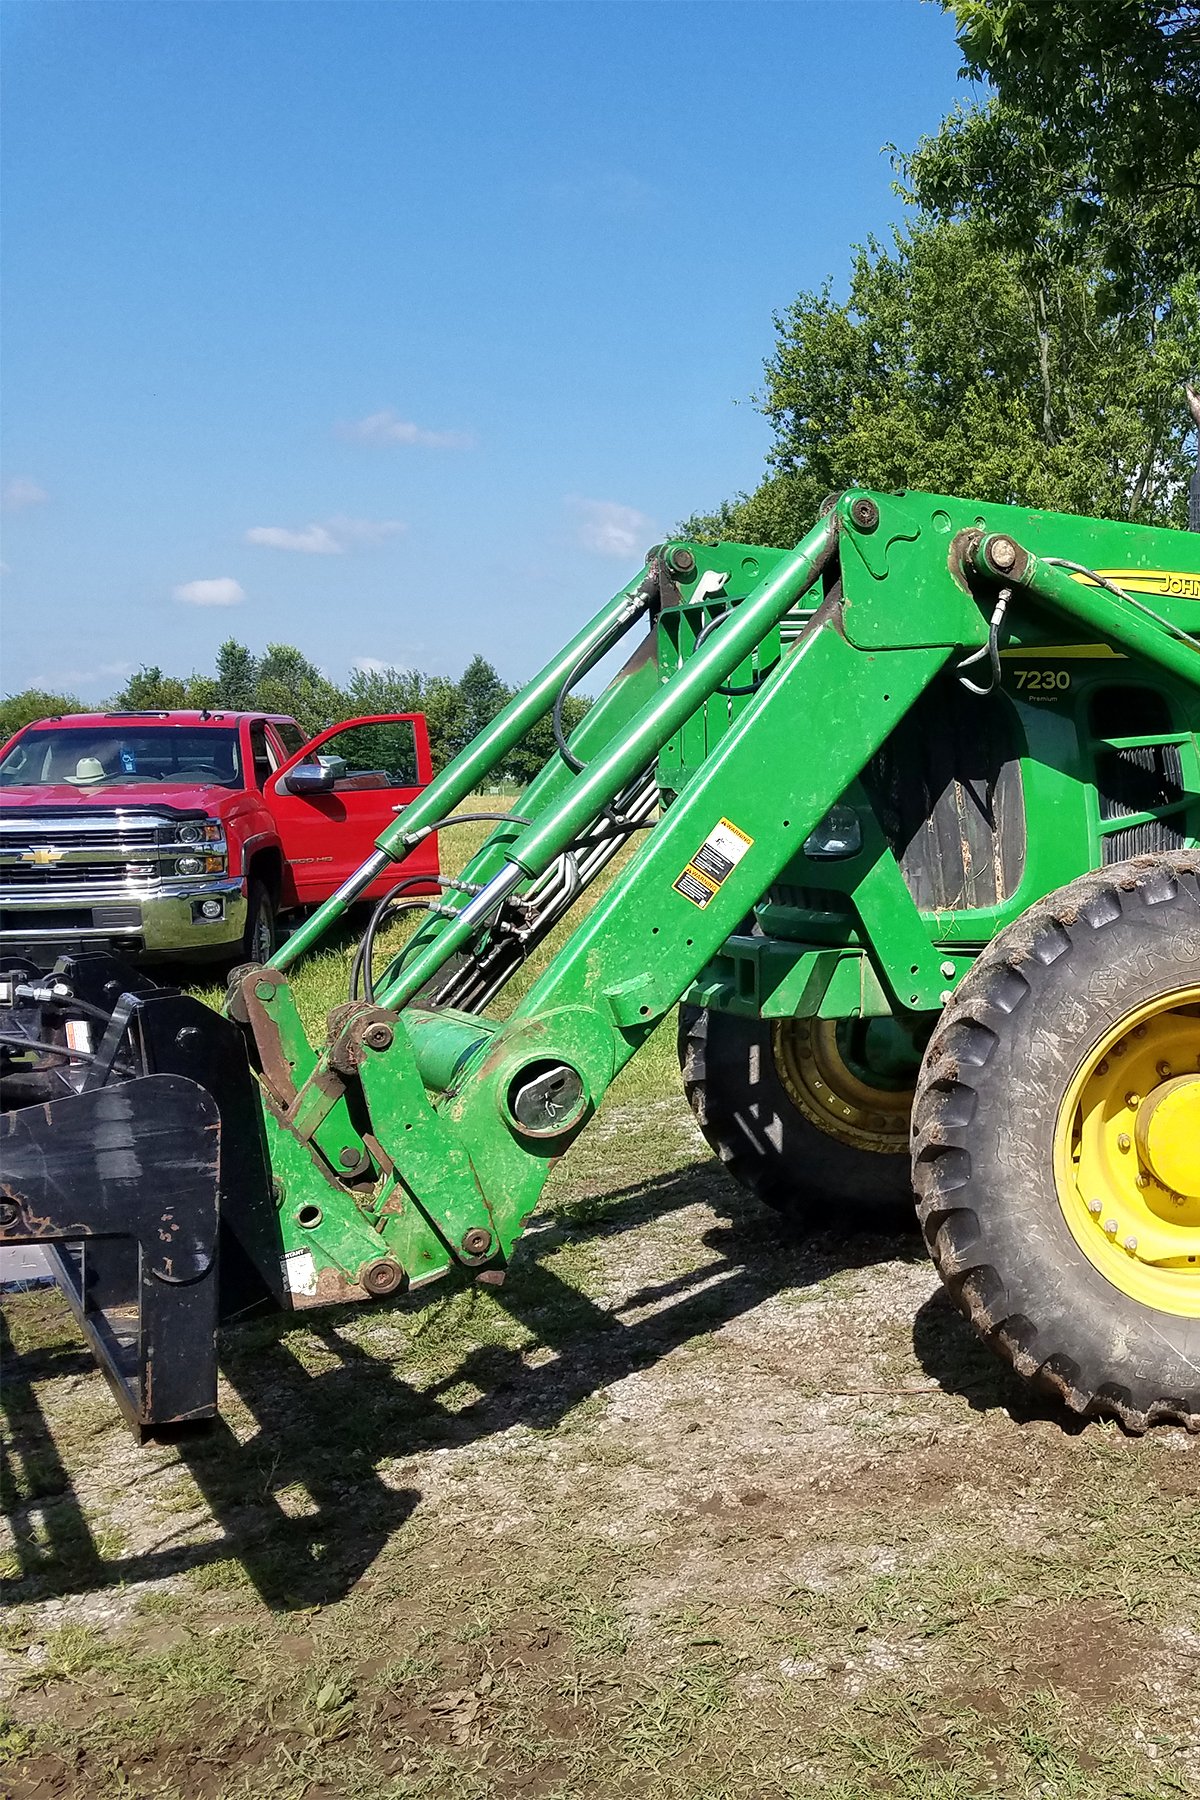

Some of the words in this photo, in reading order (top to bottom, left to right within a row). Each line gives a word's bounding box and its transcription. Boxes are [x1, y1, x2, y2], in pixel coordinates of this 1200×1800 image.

[1013, 670, 1070, 690] 7230
[726, 822, 752, 845] WARNING
[691, 869, 718, 891] WARNING
